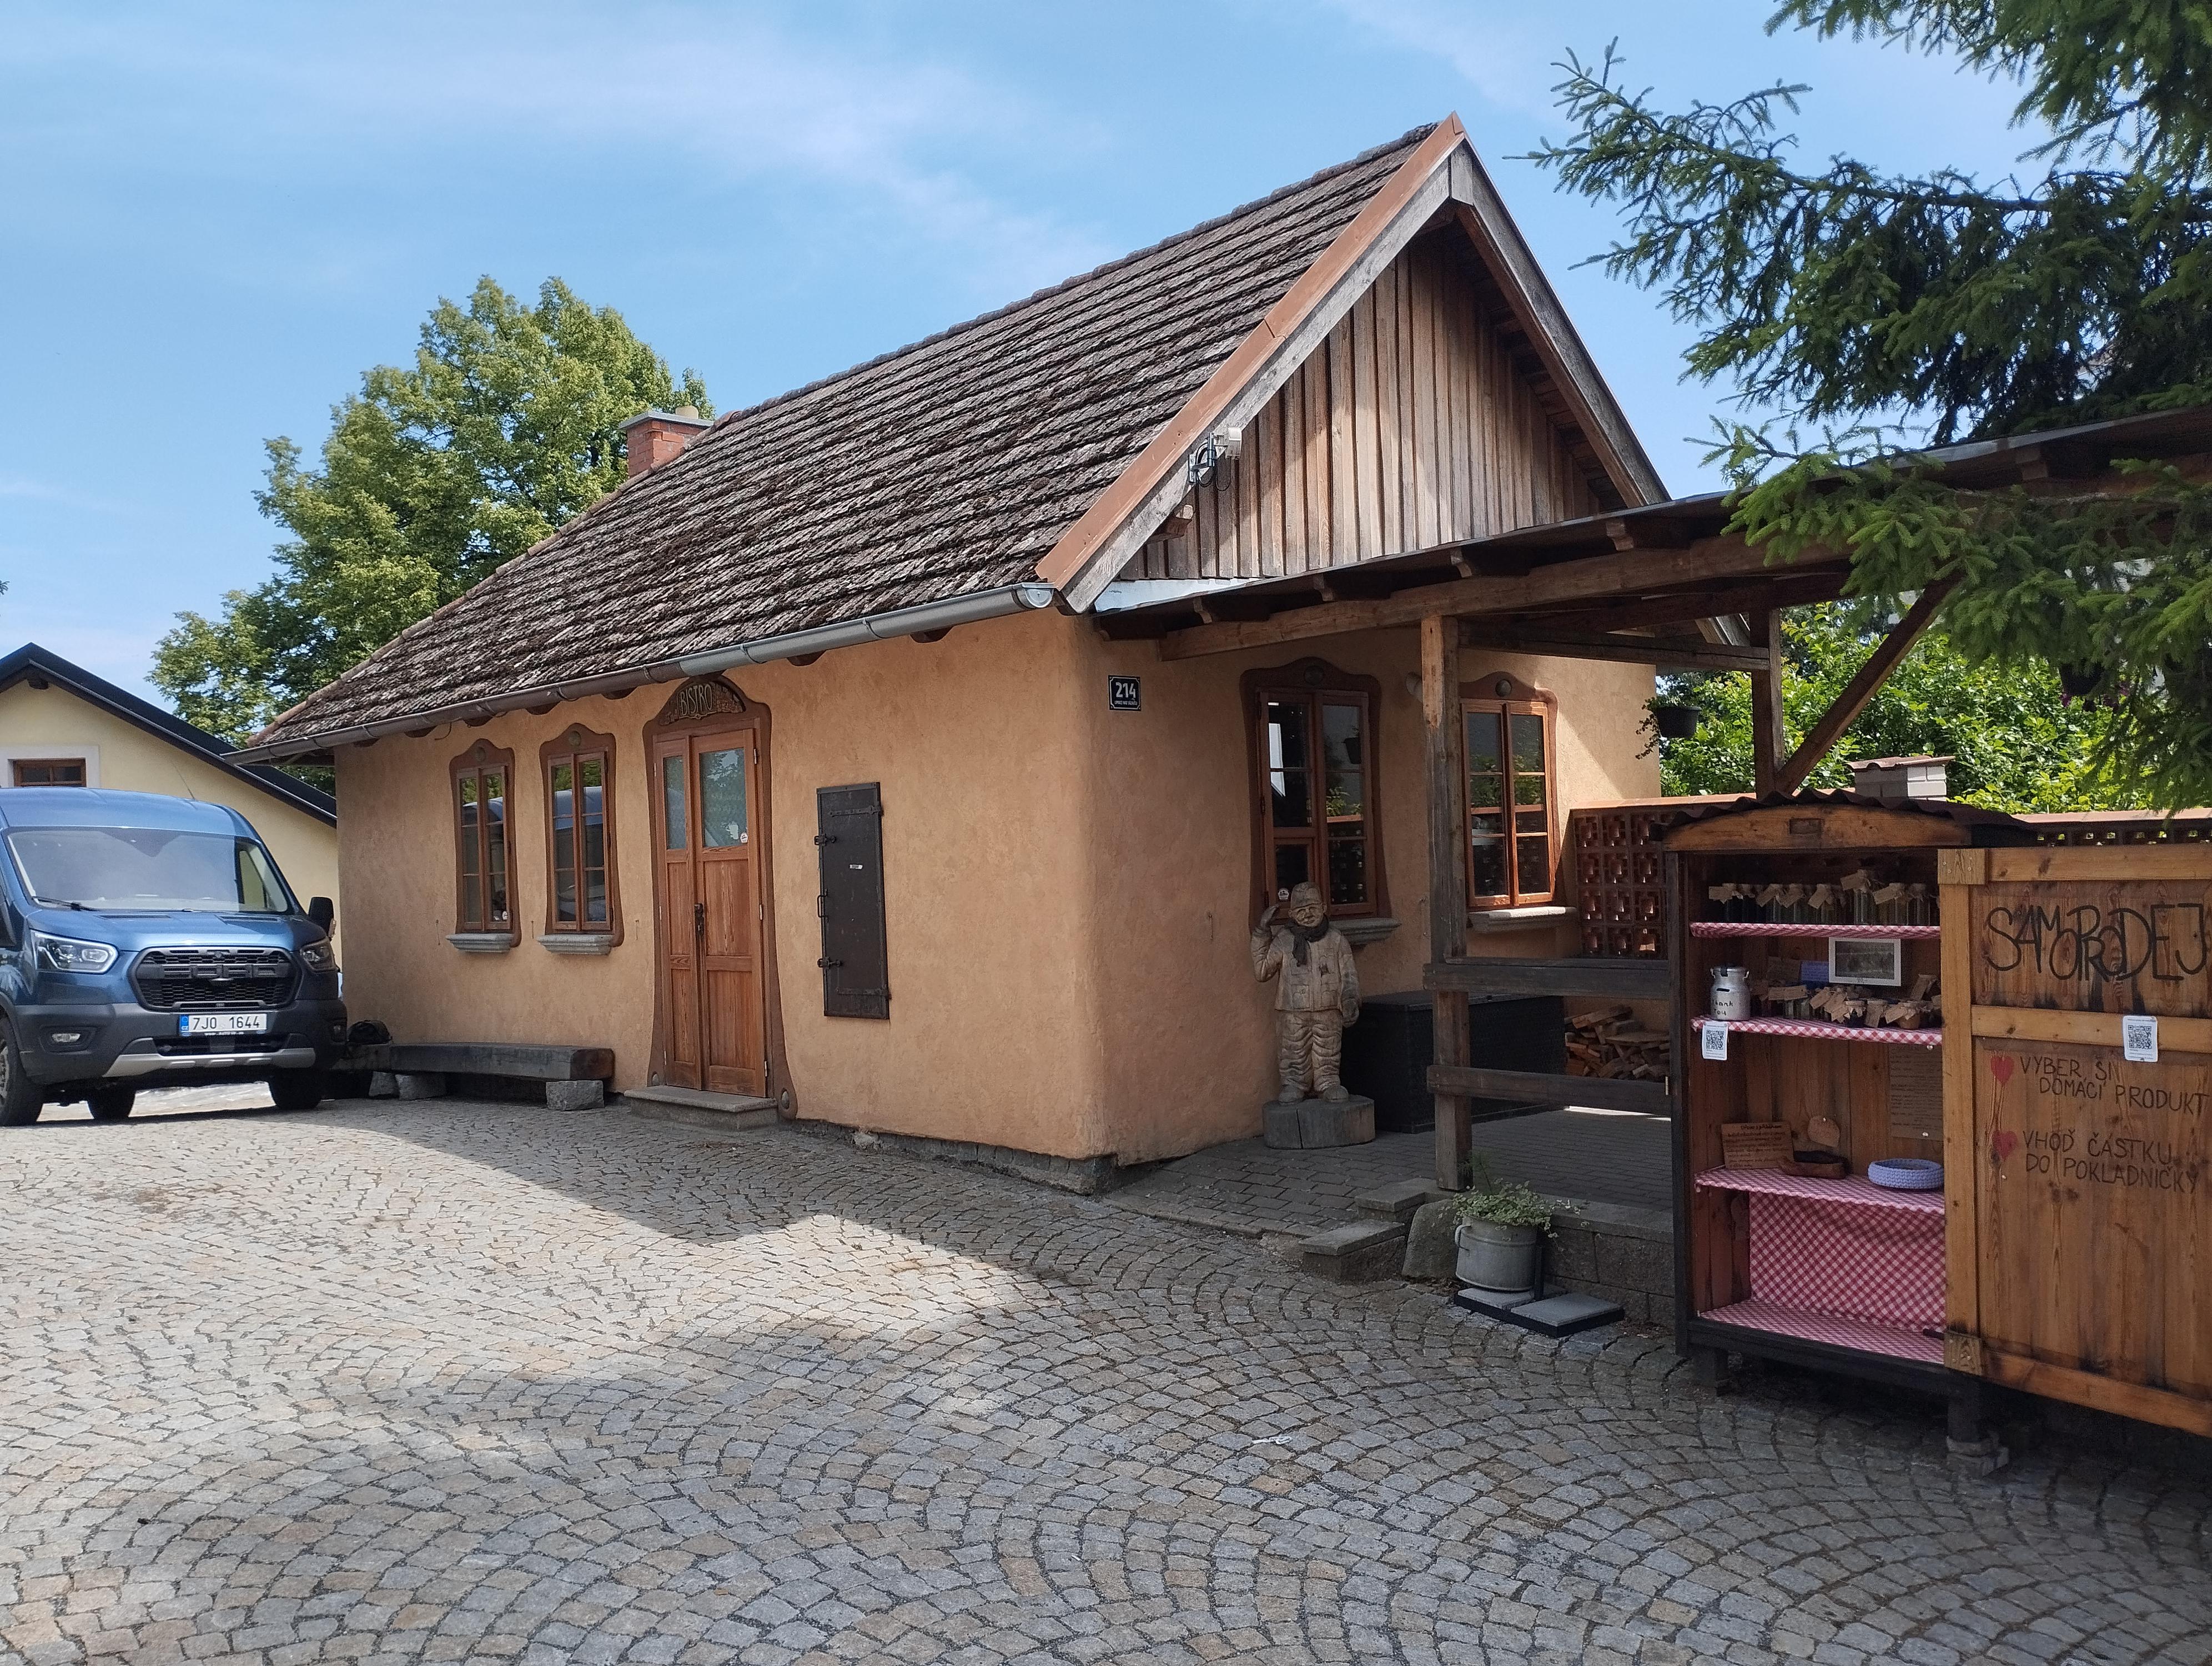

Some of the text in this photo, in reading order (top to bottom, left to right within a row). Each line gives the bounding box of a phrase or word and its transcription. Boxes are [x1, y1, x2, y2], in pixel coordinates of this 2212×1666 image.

[679, 684, 713, 716] BISTRO
[1115, 682, 1136, 698] 214
[1983, 902, 2208, 982] SAMOPRODEJ
[193, 1016, 260, 1030] 7J0 1644
[2020, 1056, 2082, 1078] VYBER
[2039, 1077, 2210, 1117] DOMÁCÍ PRODUKT
[2022, 1129, 2172, 1166] VHOĎ ČÁSTKU
[2026, 1153, 2199, 1193] DO POKLADNIČKY
